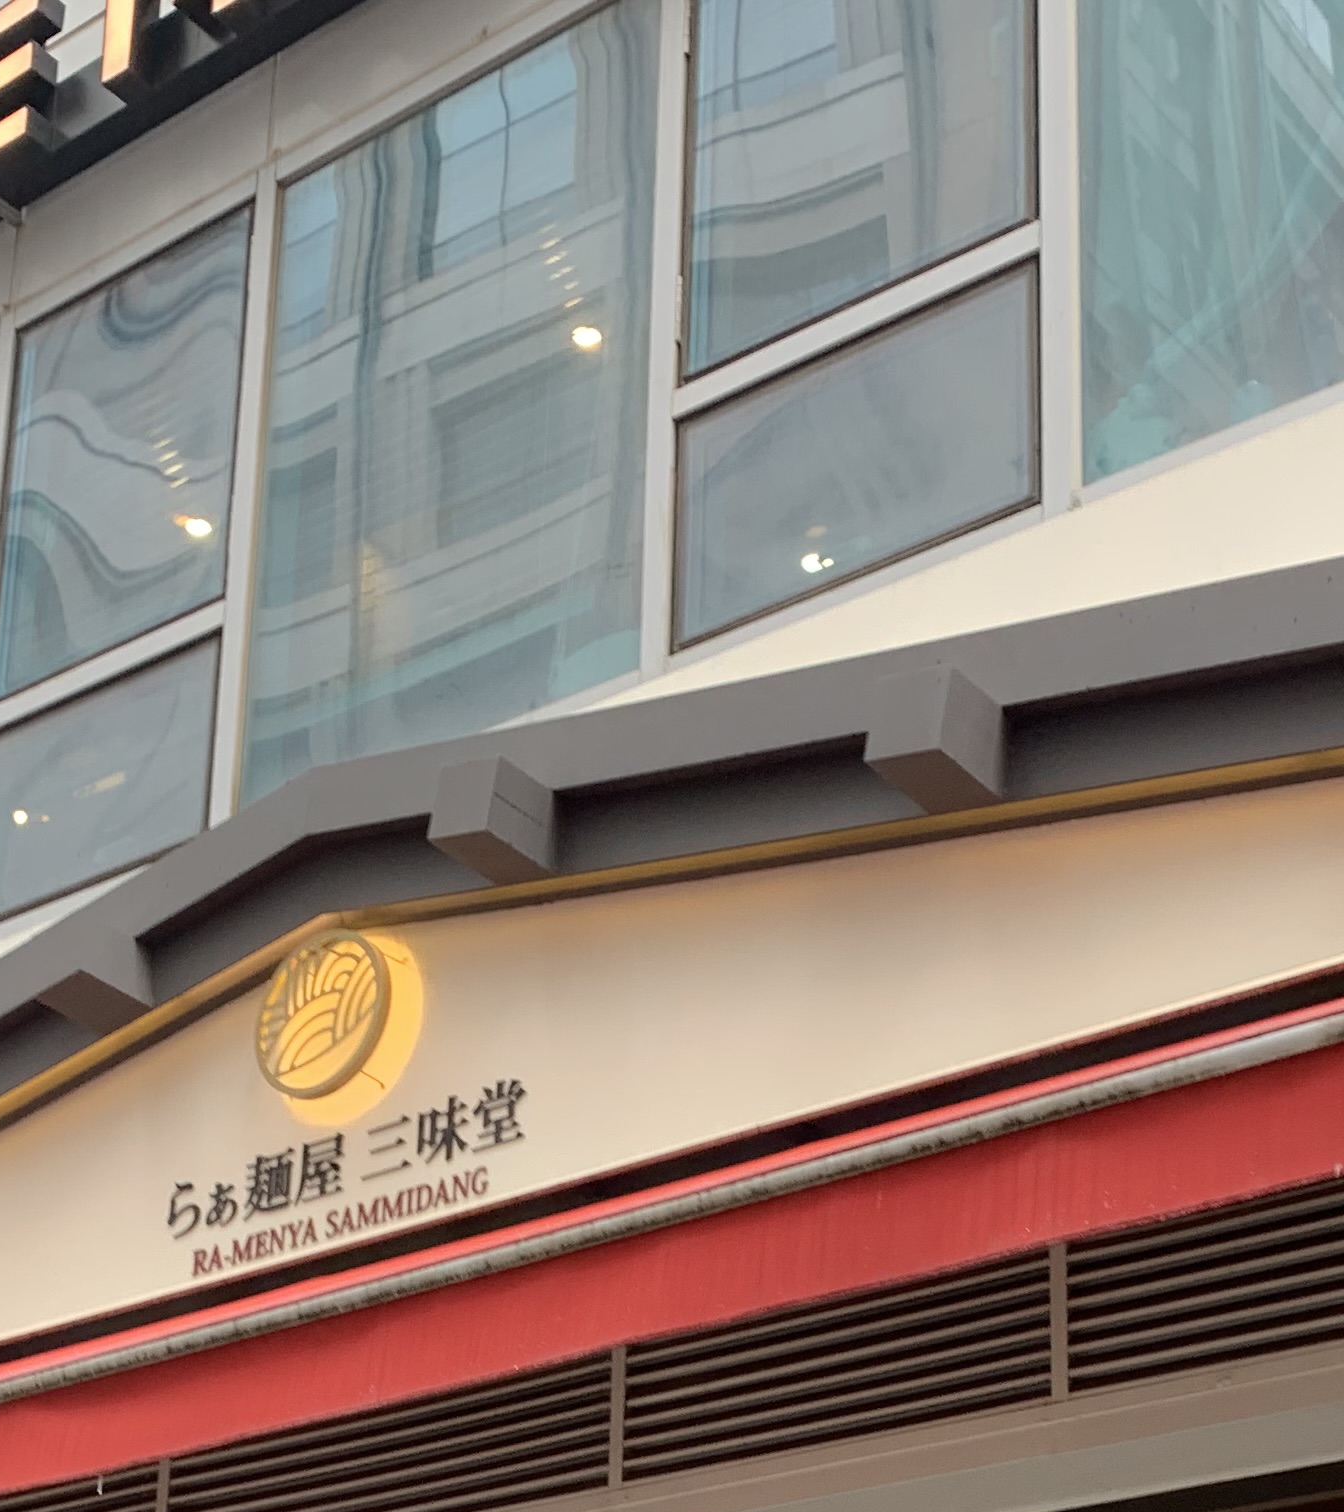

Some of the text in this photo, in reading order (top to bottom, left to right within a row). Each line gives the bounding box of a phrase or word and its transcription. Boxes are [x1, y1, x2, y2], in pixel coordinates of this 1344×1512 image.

[360, 1078, 526, 1183] 三味堂
[191, 1166, 490, 1277] RA-MENYA SAMMIDANG
